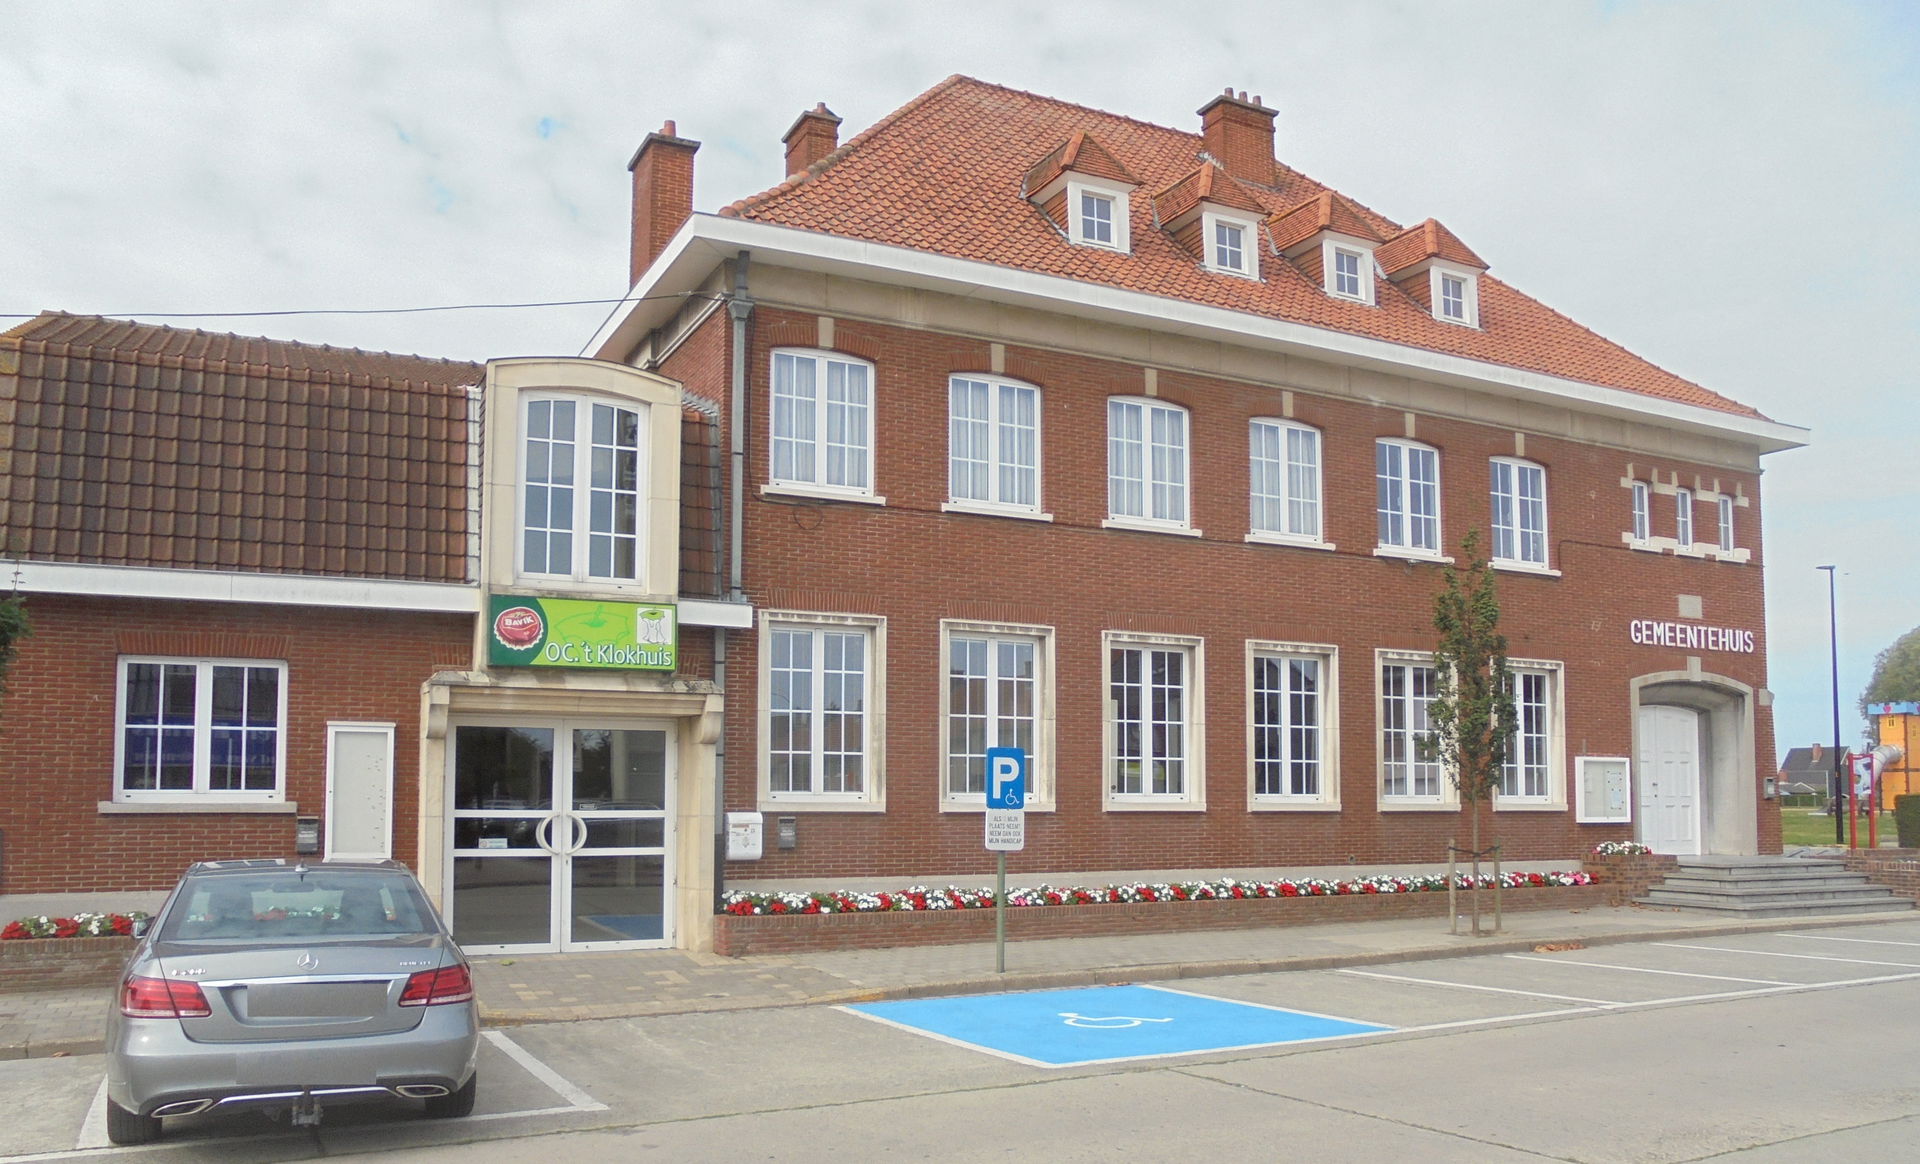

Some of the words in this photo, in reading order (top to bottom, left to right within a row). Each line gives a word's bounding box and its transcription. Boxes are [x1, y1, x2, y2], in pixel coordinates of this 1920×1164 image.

[1630, 619, 1754, 653] GEMEENTEHUIS
[546, 642, 579, 662] OC.
[597, 644, 672, 666] Klokhuis
[993, 757, 1020, 799] P
